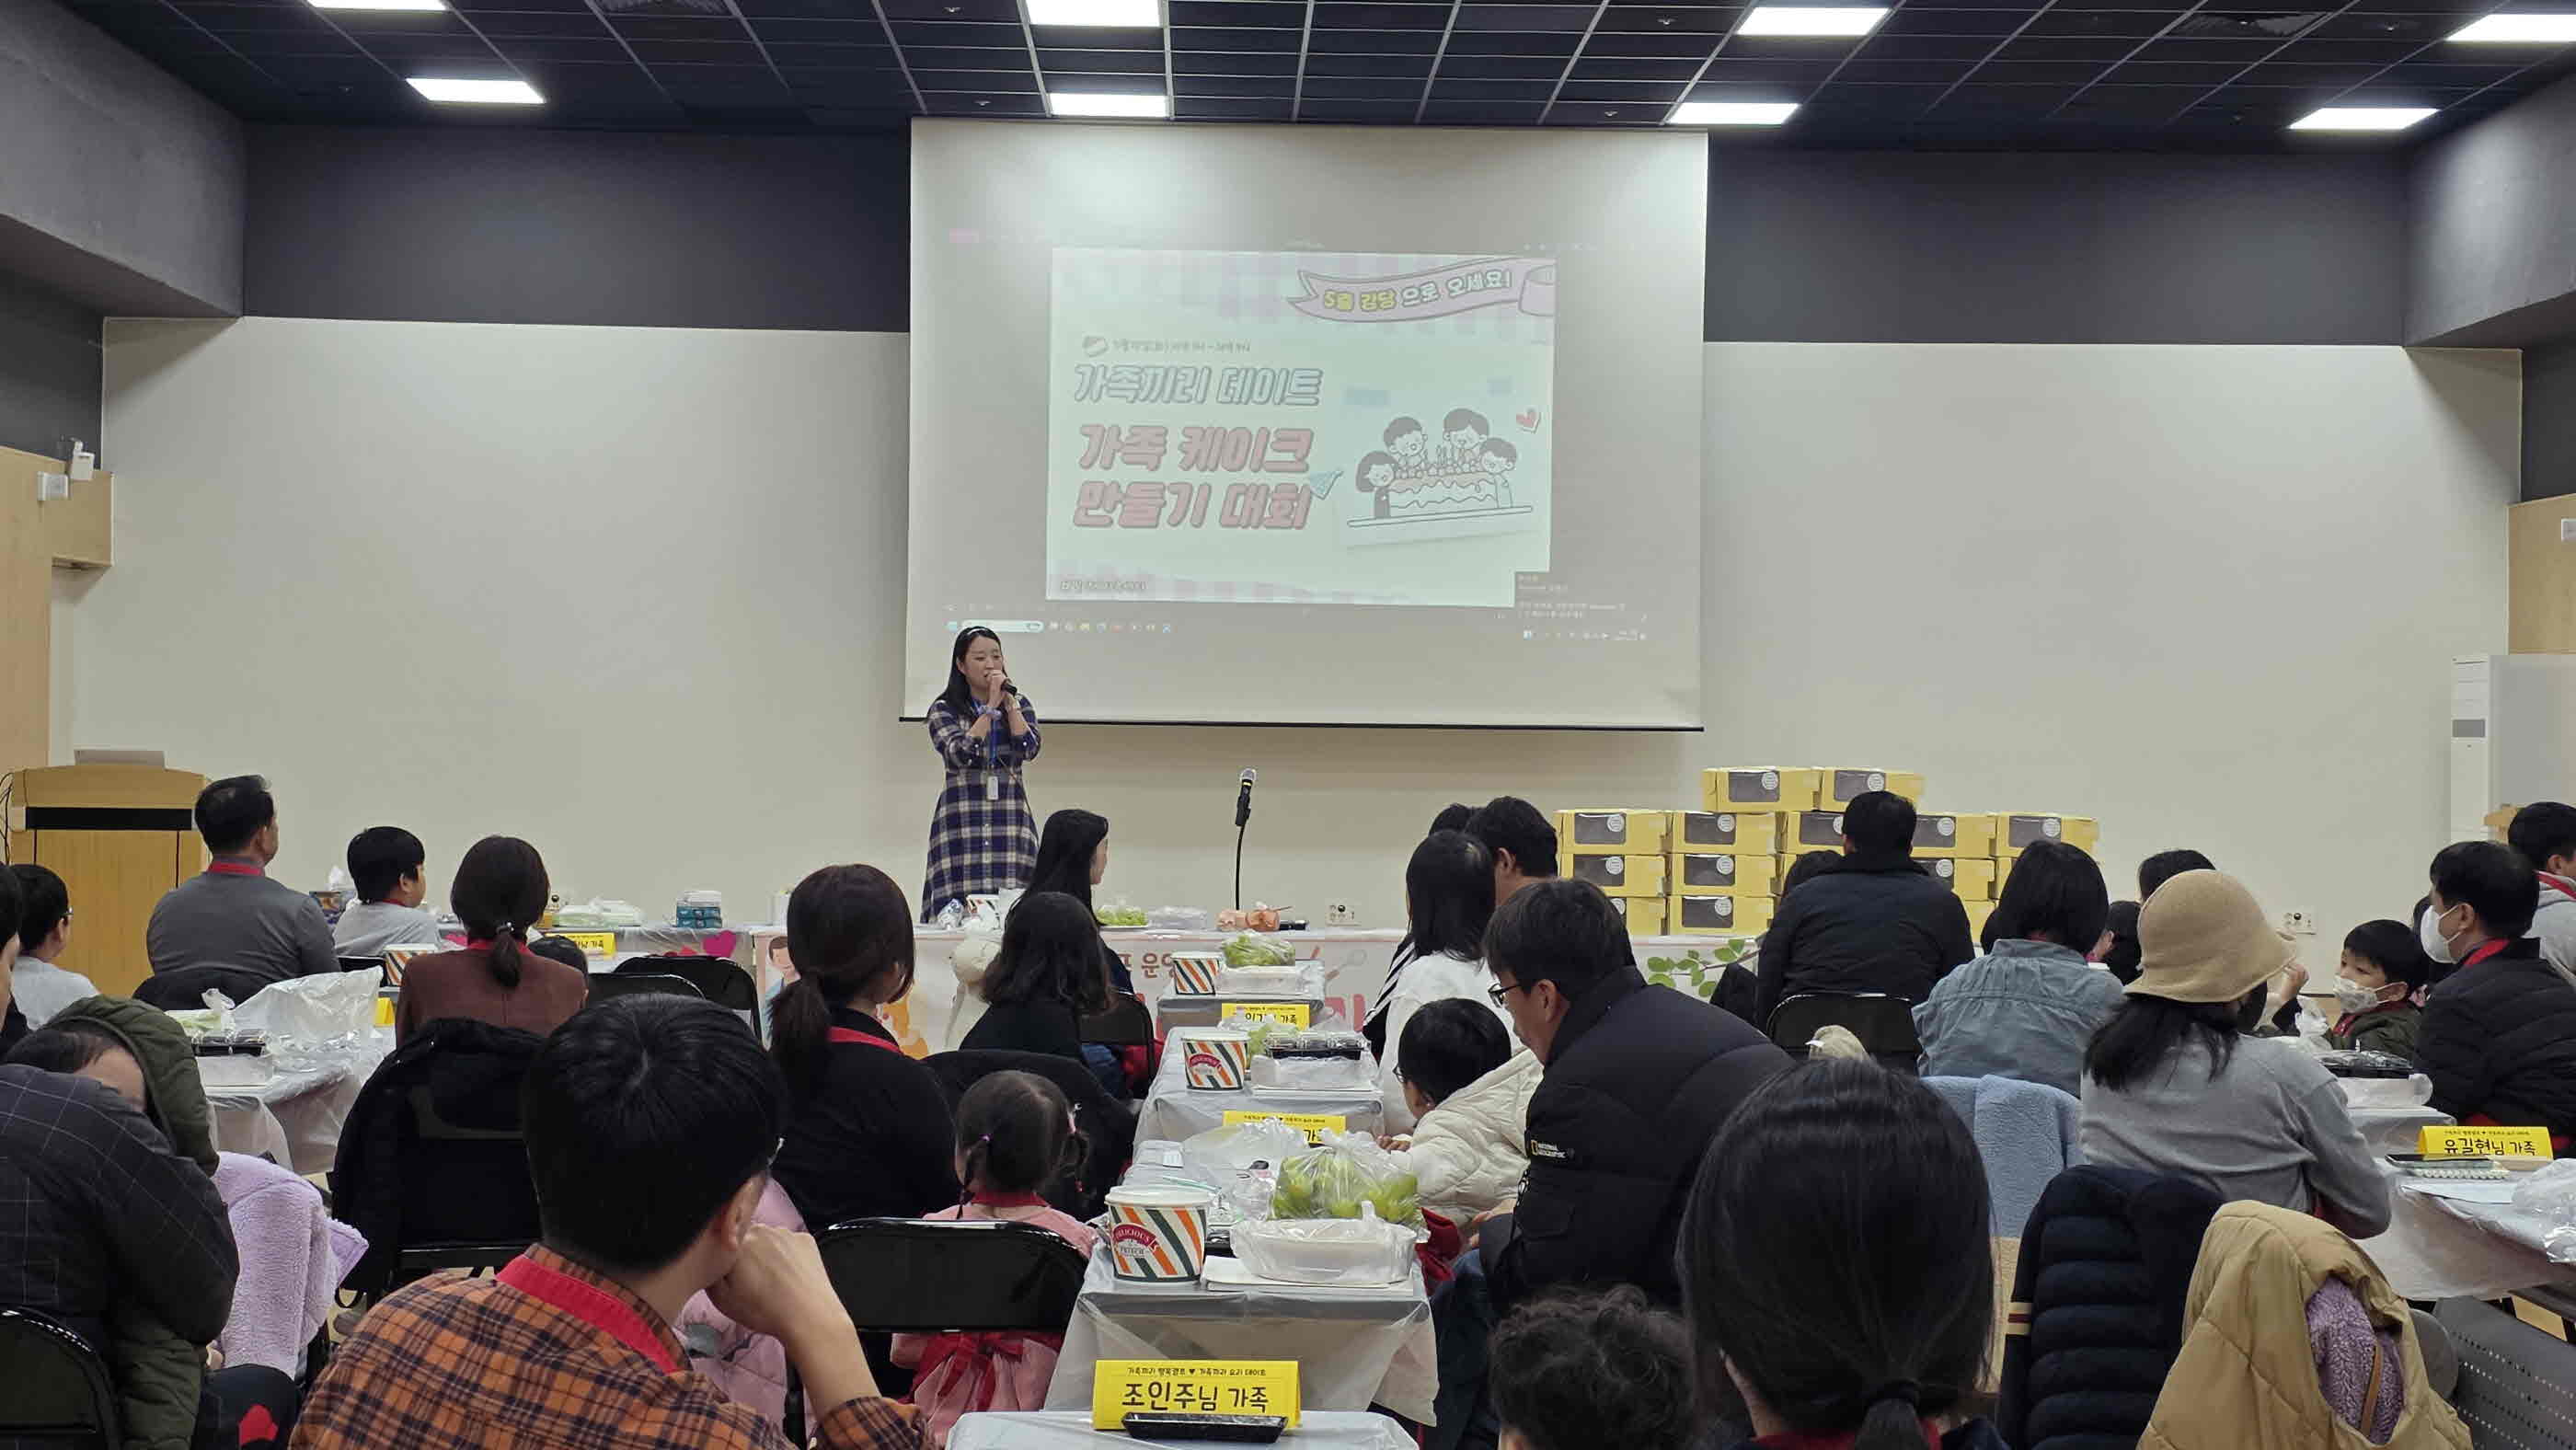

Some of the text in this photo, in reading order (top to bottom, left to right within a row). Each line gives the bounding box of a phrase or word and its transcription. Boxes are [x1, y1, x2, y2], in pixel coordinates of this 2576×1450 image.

[1075, 363, 1324, 407] 가족끼리 데이트
[1078, 423, 1315, 474] 가족 케이크
[1074, 480, 1312, 530] 만들기 대회
[2444, 1138, 2536, 1156] 유길현님 가족
[1121, 1381, 1269, 1413] 조인주님 가족
